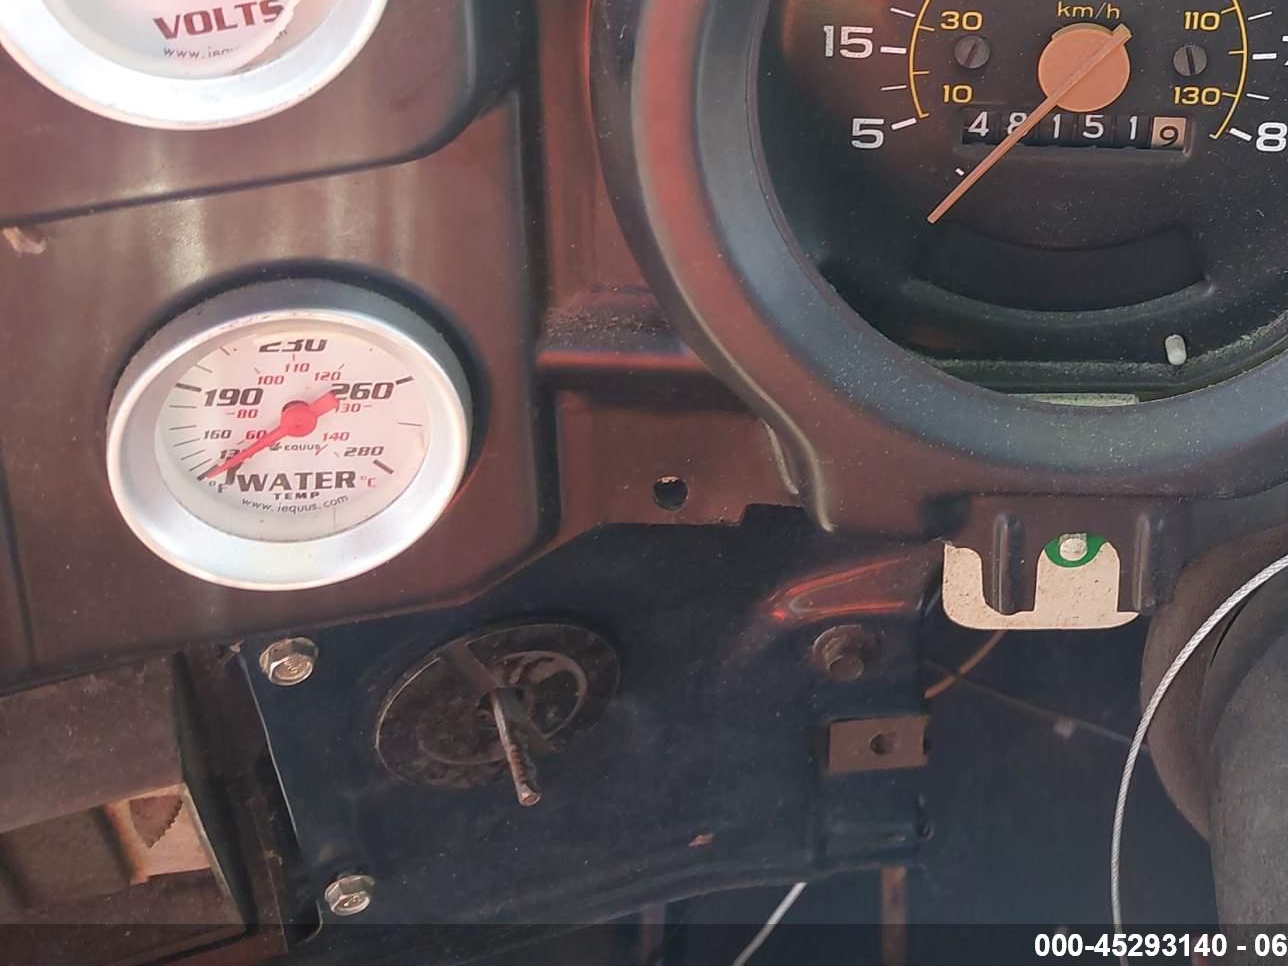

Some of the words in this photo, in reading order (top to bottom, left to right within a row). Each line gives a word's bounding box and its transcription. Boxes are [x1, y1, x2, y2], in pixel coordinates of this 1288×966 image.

[1056, 1, 1120, 20] km/h
[940, 11, 983, 31] 30
[1183, 11, 1220, 31] 110
[822, 25, 873, 58] 15
[943, 85, 972, 103] 10
[1173, 86, 1221, 106] 130
[851, 118, 884, 149] 5
[285, 362, 310, 373] 110
[314, 371, 341, 381] 120
[257, 375, 285, 385] 100
[204, 387, 264, 407] 190
[331, 382, 395, 401] 260
[237, 408, 258, 418] 80
[203, 429, 232, 440] 160
[322, 432, 350, 442] 140
[344, 446, 385, 457] 280
[237, 471, 356, 492] WATER
[274, 491, 320, 501] TEMP
